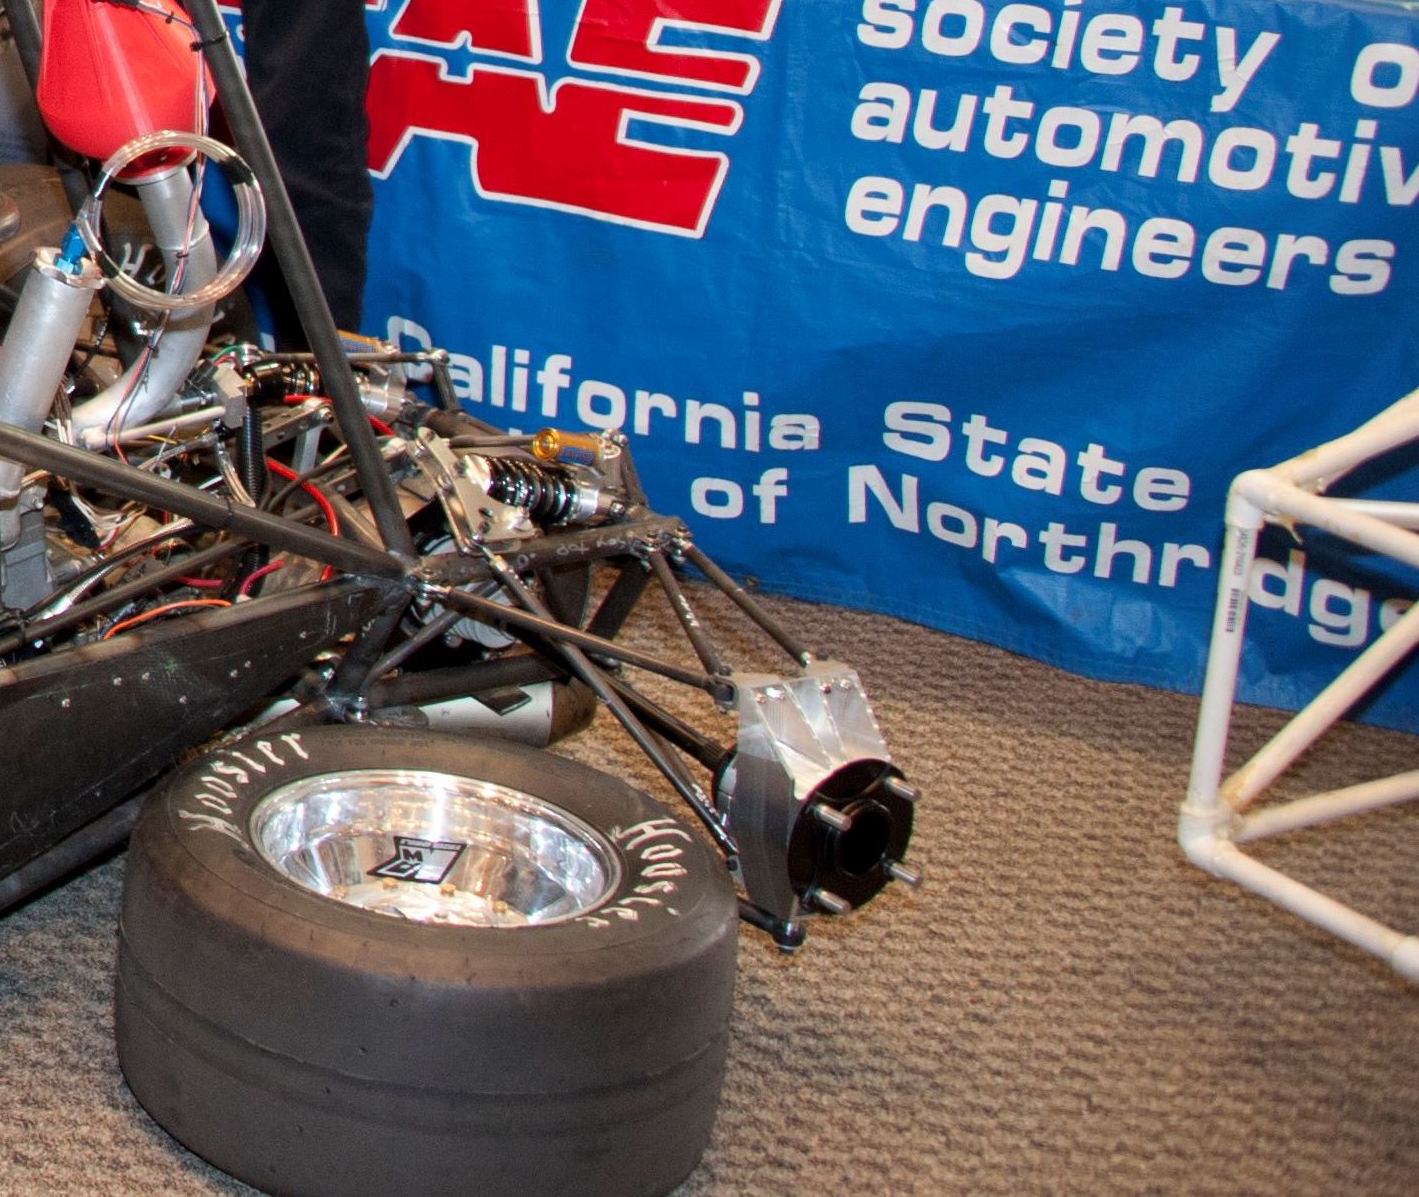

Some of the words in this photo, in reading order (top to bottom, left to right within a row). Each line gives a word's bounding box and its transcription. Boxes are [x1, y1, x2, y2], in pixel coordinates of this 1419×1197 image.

[844, 176, 1396, 295] engineers
[386, 315, 820, 452] California
[882, 400, 1191, 511] State
[690, 467, 788, 524] of
[847, 464, 1415, 648] Northrdg
[178, 732, 309, 851] Hoosier
[574, 816, 694, 929] Hoosier
